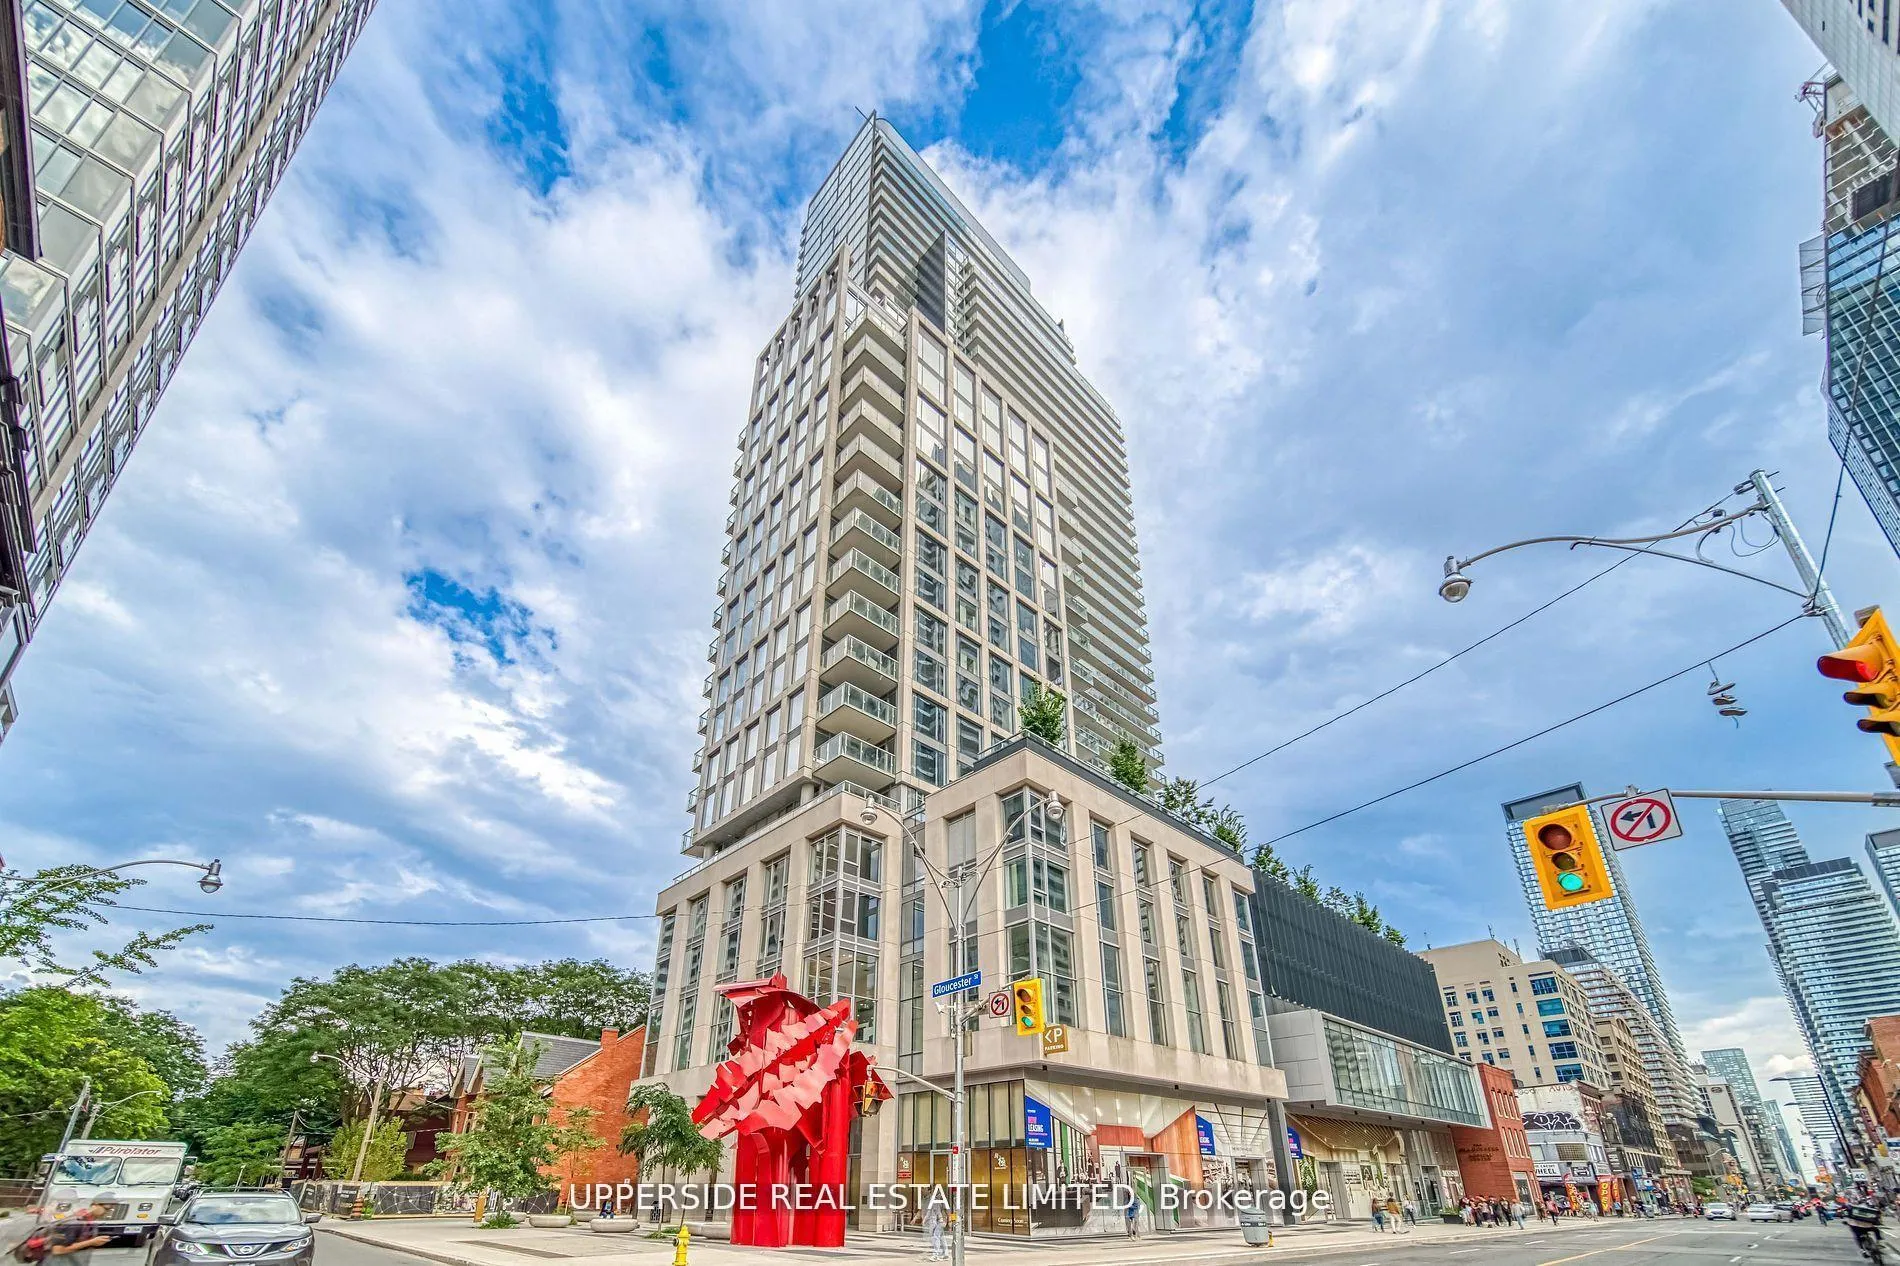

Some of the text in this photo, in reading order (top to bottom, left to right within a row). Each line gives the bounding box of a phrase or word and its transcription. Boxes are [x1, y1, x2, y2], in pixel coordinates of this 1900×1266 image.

[934, 978, 972, 995] Gloucester
[1053, 1027, 1063, 1043] P
[102, 1147, 161, 1155] Purolator
